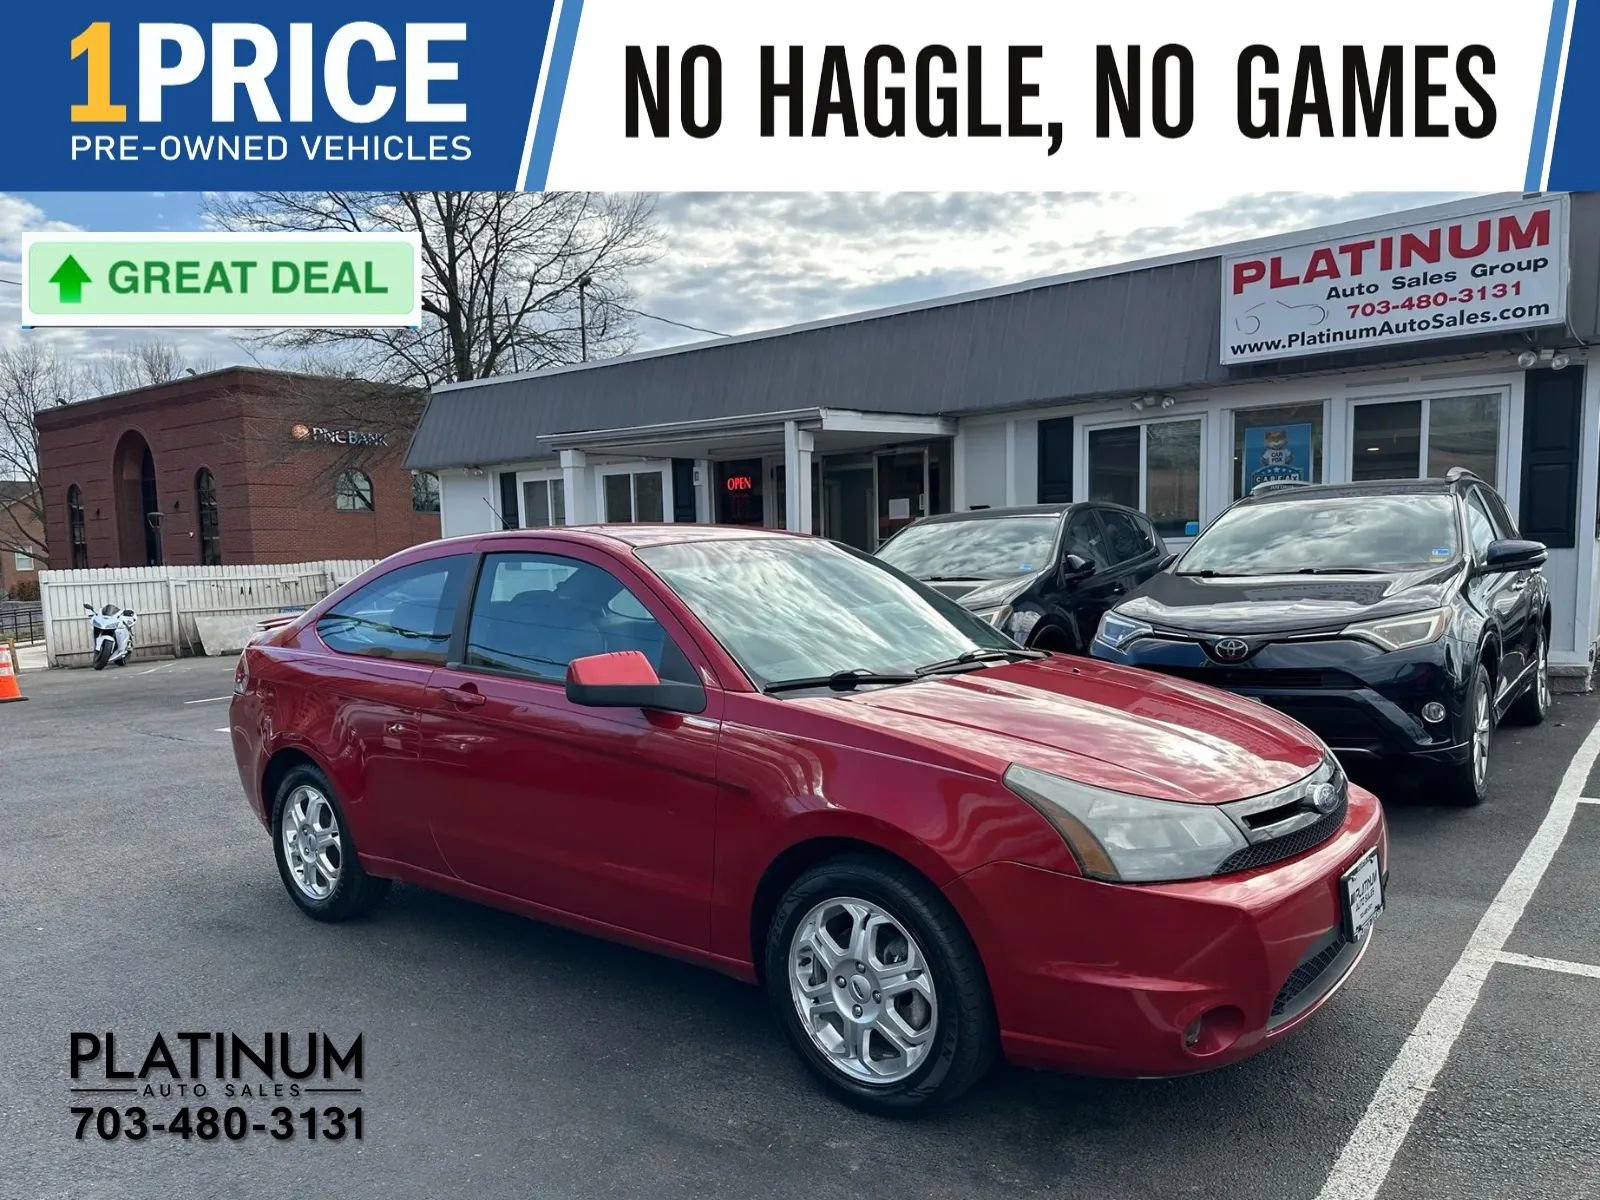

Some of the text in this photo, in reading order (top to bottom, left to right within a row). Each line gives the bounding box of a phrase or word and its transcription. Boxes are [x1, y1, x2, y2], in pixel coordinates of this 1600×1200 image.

[1233, 209, 1550, 295] PLATINUM
[1326, 256, 1549, 300] Auto Sales Group
[1347, 280, 1522, 319] 703-480-3131
[1230, 301, 1550, 356] www.PlatinumAutoSales.com
[727, 476, 752, 491] OPEN
